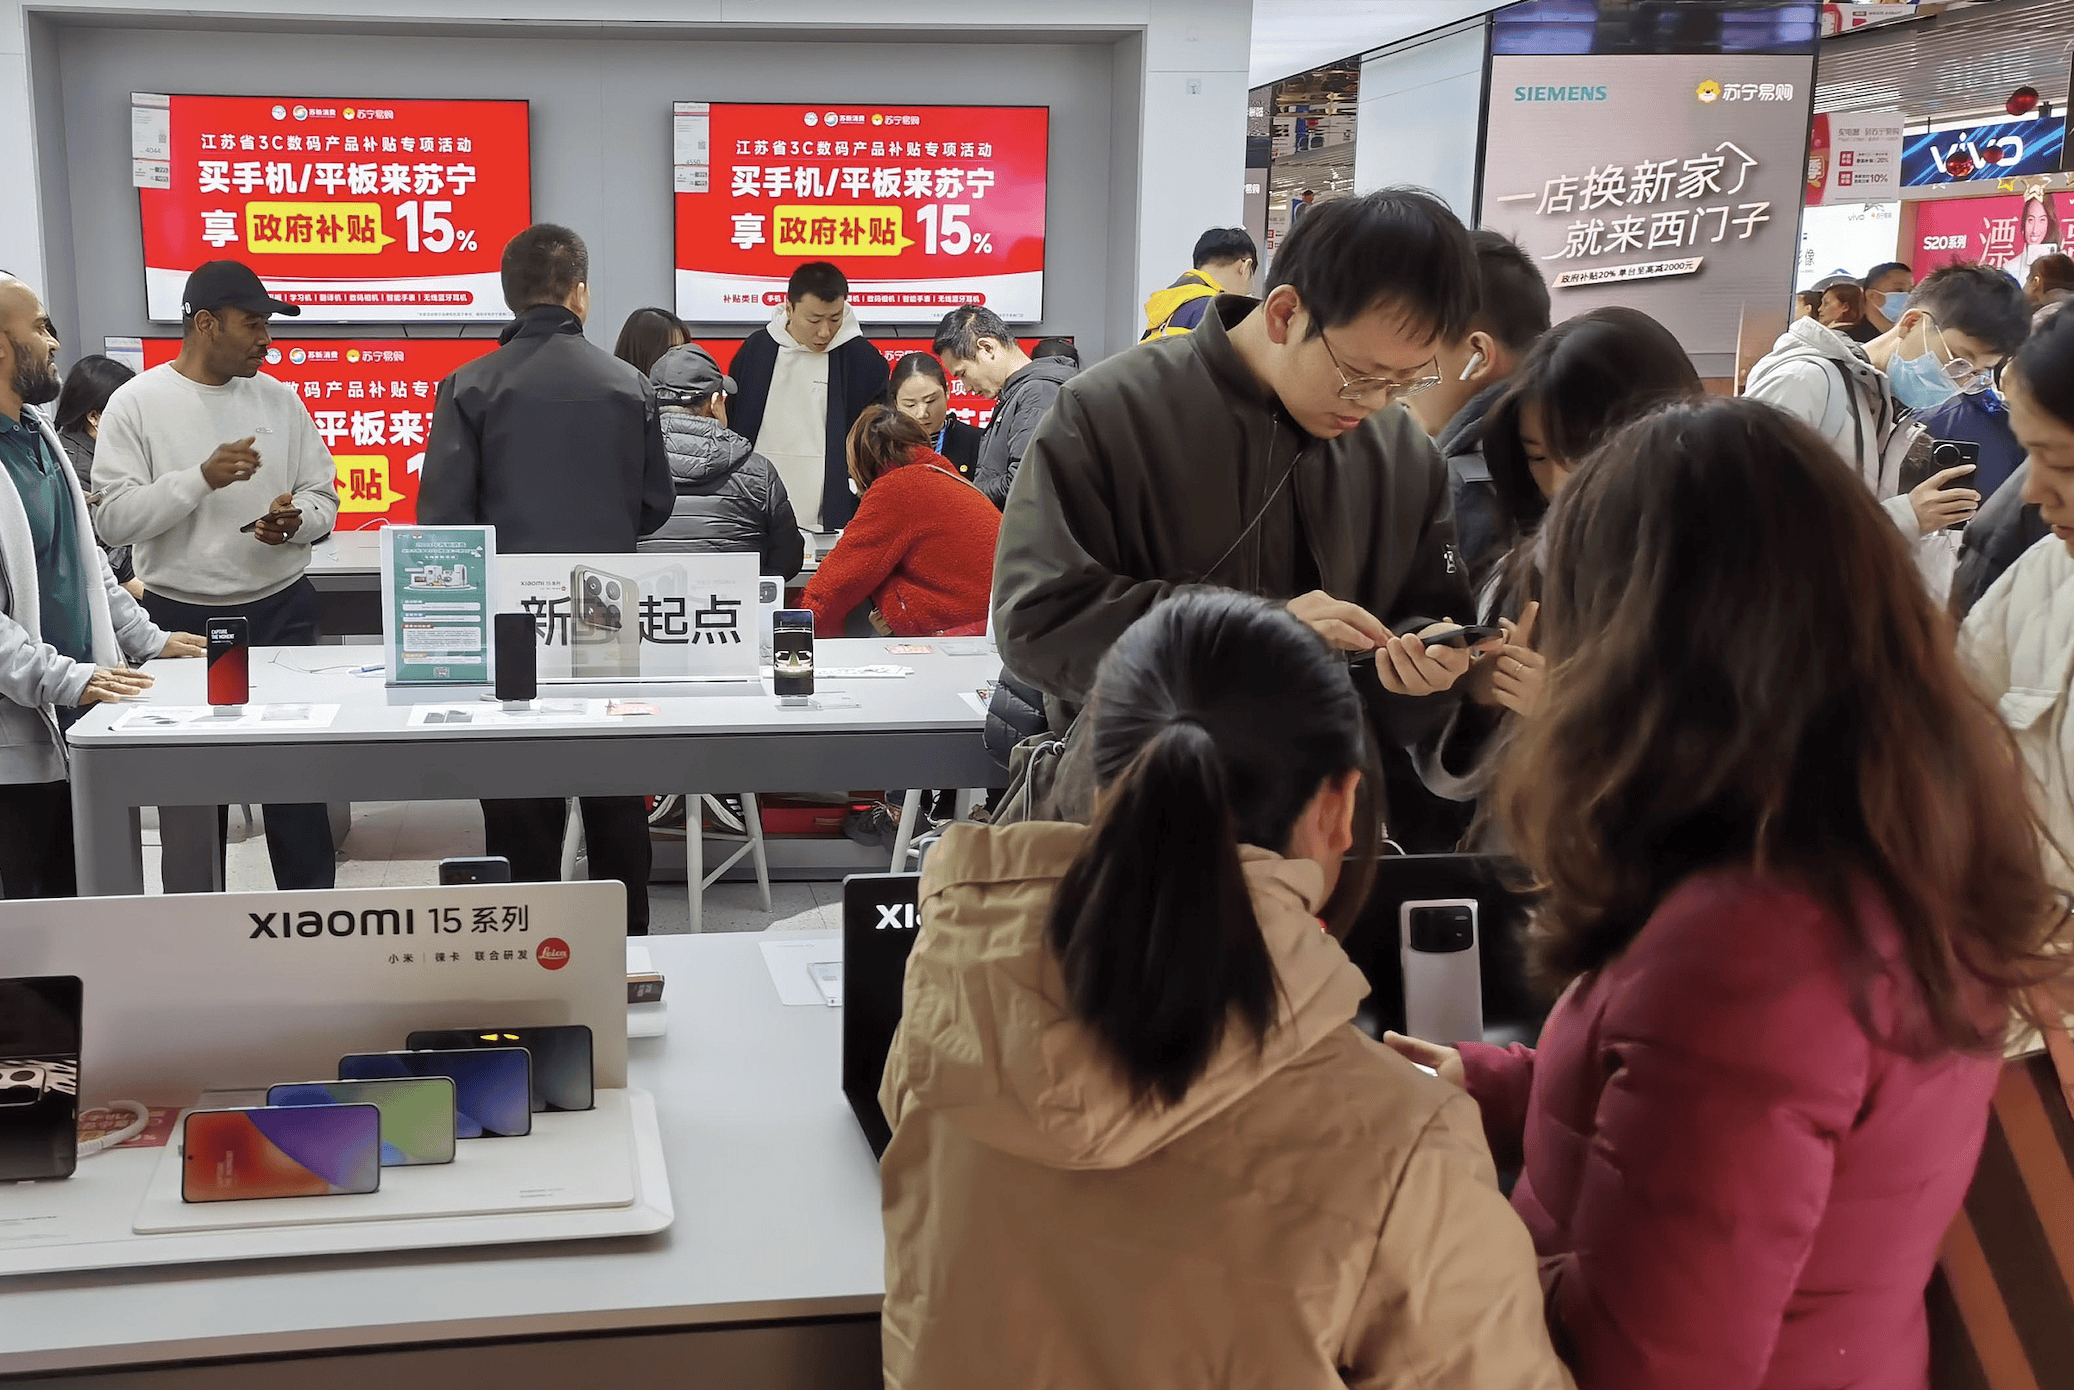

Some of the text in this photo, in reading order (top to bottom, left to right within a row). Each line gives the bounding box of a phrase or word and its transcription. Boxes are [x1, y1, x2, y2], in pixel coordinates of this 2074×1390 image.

[1514, 86, 1608, 101] SIEMENS
[1722, 83, 1794, 101] 苏宁易购
[356, 109, 395, 120] 苏宁易购
[201, 133, 473, 153] 江苏省3C数码产品补贴专项活动
[735, 139, 993, 158] 江苏省3C数码产品补贴专项活动
[198, 160, 476, 196] 买手机/平板来苏宁
[730, 165, 995, 199] 买手机/平板来苏宁
[1497, 152, 1727, 215] 一店换新家
[200, 200, 478, 254] 享 政府补贴 15%
[731, 203, 993, 256] 享 政府补贴 15%
[1541, 201, 1771, 261] 就来西门子
[1923, 234, 1968, 250] S20系列
[1978, 216, 2019, 271] 漂
[723, 294, 759, 304] 补贴类目
[362, 350, 405, 362] 苏宁易购
[520, 596, 572, 646] 新
[638, 594, 742, 646] 起点
[428, 908, 462, 935] 15
[470, 904, 530, 934] 系列
[388, 953, 414, 964] 小米
[474, 950, 528, 962] 联合研发
[538, 947, 568, 960] Leica
